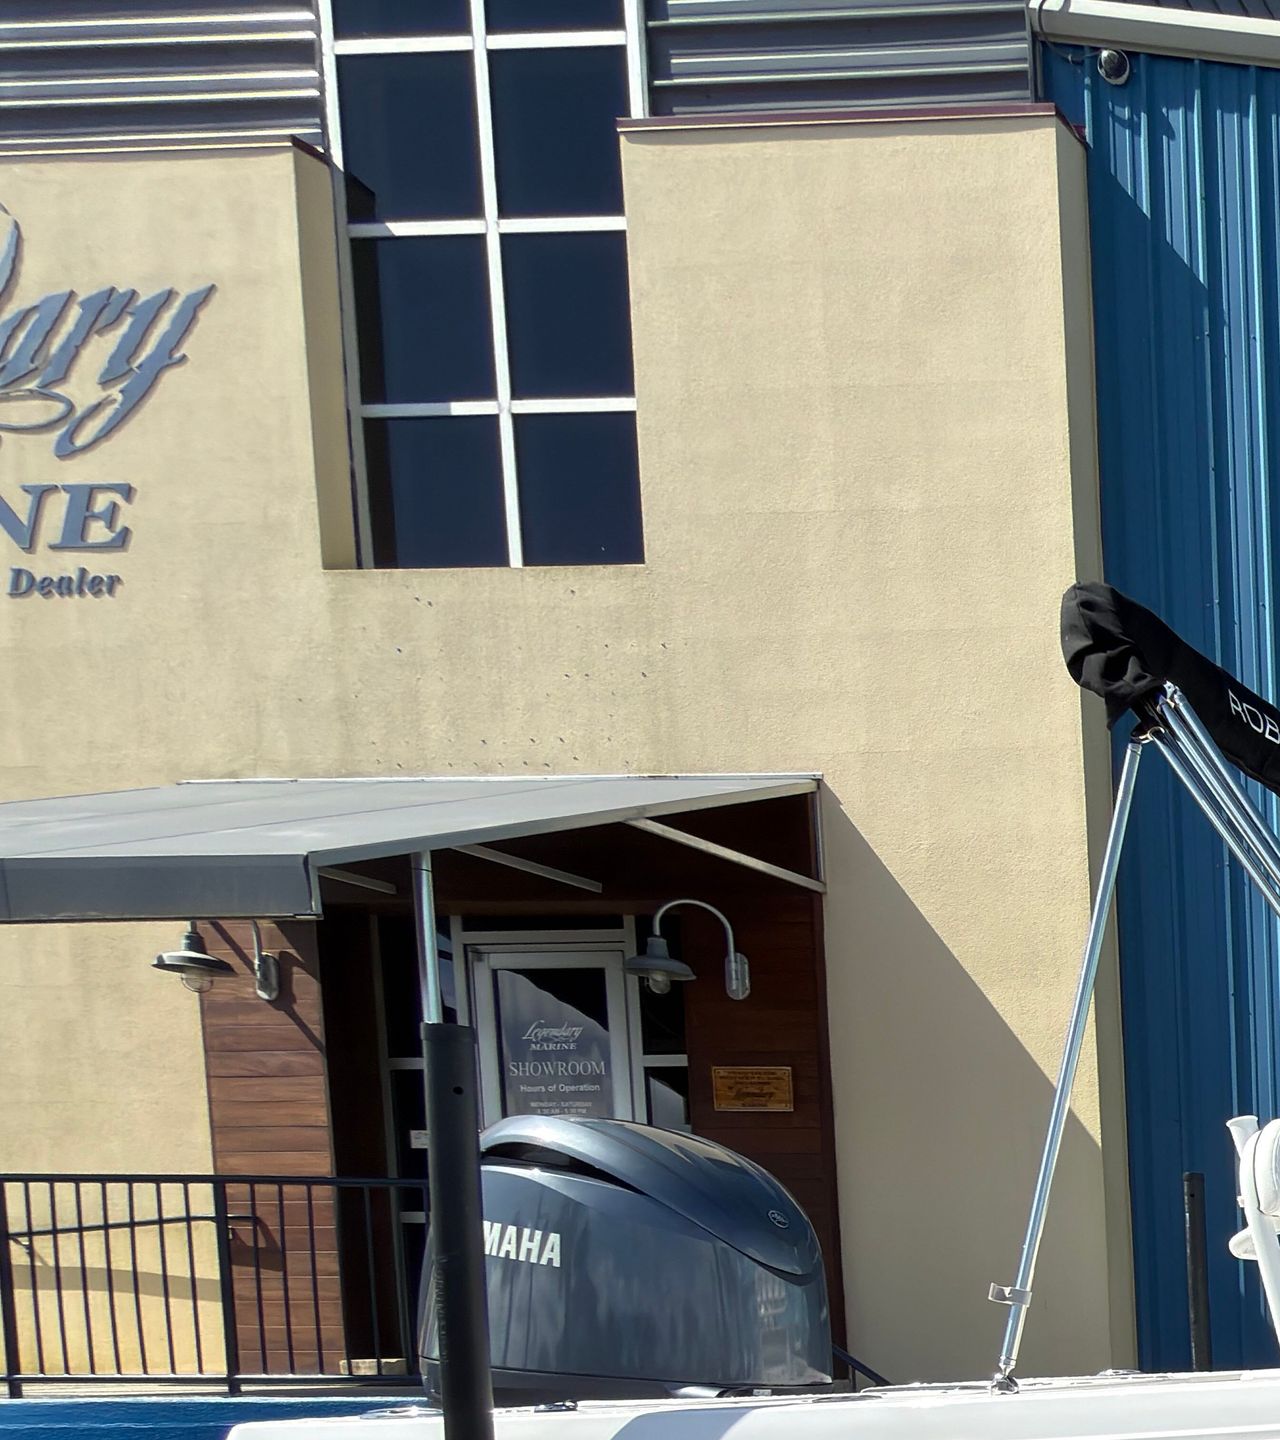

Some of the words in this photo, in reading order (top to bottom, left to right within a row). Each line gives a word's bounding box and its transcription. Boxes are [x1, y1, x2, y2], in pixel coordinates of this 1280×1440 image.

[8, 567, 122, 598] Dealer
[522, 1020, 583, 1042] Legendary
[509, 1061, 606, 1076] SHOWROOM
[520, 1084, 545, 1092] Hours
[547, 1084, 556, 1092] of
[559, 1084, 600, 1093] Operation
[483, 1220, 561, 1267] MAHA
